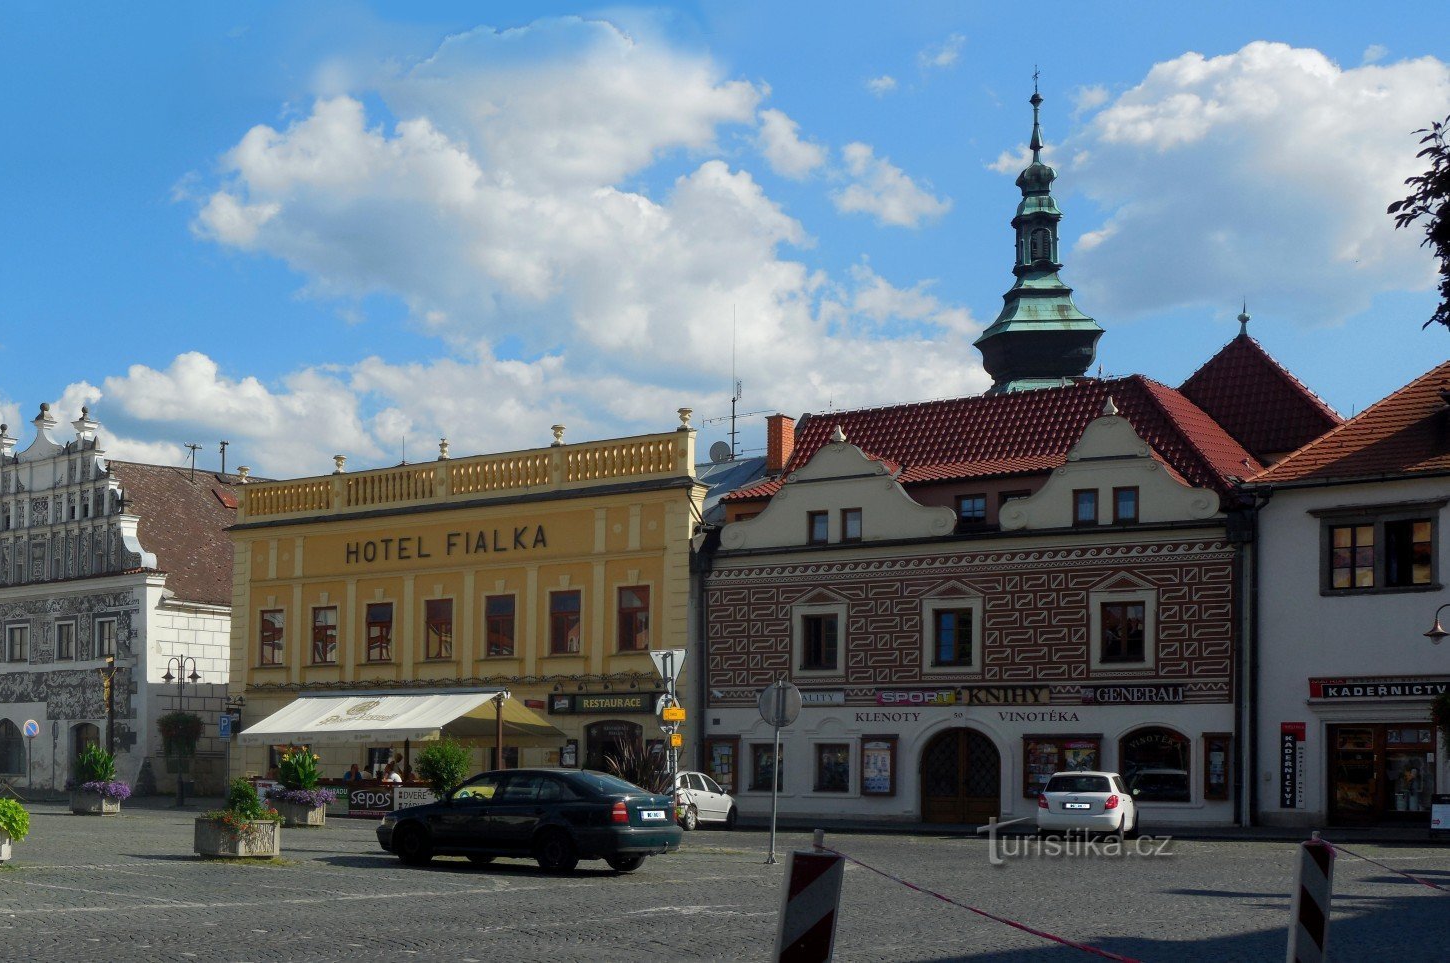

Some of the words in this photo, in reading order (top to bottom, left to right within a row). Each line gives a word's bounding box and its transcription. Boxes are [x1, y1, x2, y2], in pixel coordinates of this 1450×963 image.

[346, 536, 431, 564] HOTEL
[446, 525, 547, 556] FIALKA
[967, 686, 1044, 704] KNIHY
[1096, 687, 1185, 702] GENERALI
[1328, 684, 1447, 696] KADEŘNICTV
[583, 698, 642, 708] RESTAURACE
[801, 694, 835, 702] ALITY
[881, 690, 951, 704] SPORT
[855, 712, 921, 722] KLENOTY
[998, 710, 1080, 722] VINOTÉKA
[221, 717, 229, 731] P
[351, 790, 391, 808] sepos
[403, 789, 427, 799] DVEŘE
